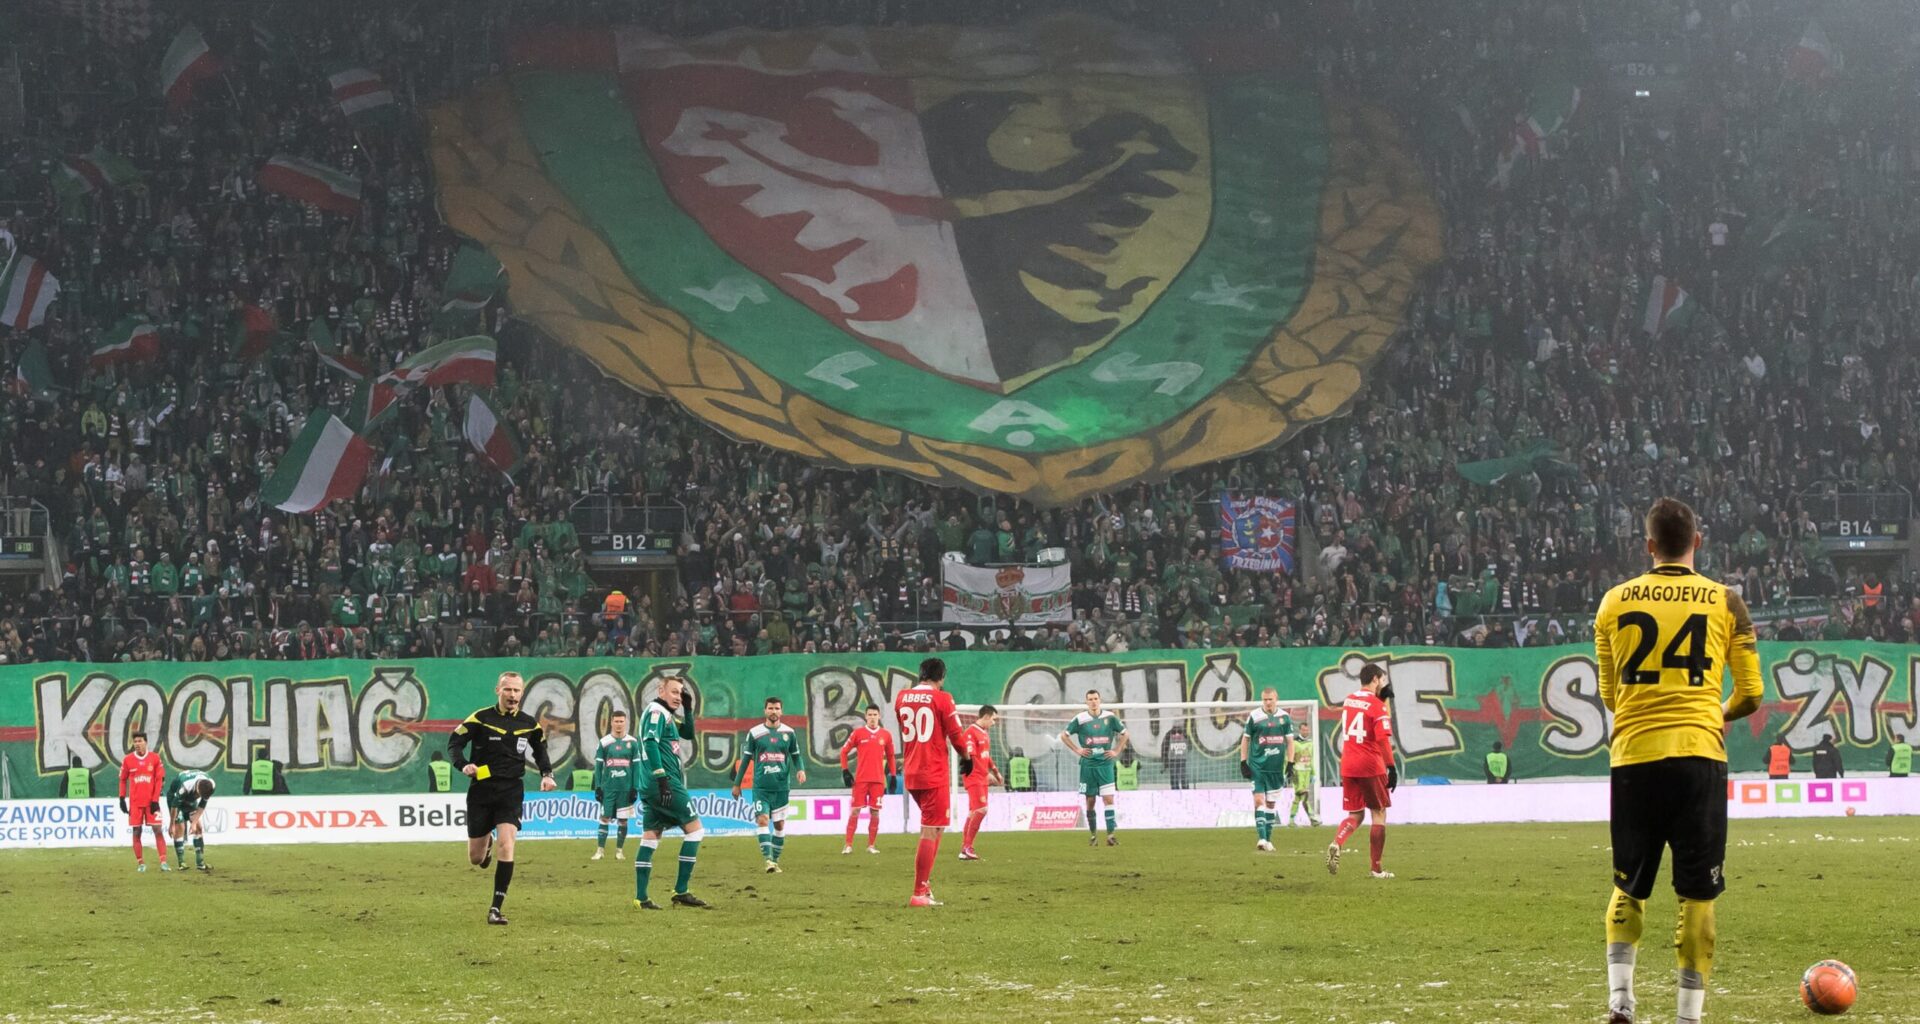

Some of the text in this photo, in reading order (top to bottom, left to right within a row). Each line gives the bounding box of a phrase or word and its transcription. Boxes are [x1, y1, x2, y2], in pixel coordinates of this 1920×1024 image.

[1626, 62, 1656, 76] B26
[1840, 520, 1873, 536] B14
[612, 534, 646, 550] B12
[1620, 585, 1718, 605] DRAGOJEVIĆ
[1617, 610, 1714, 687] 24
[901, 693, 933, 704] ABBES
[899, 706, 935, 744] 30
[1341, 709, 1368, 744] 14
[0, 805, 115, 824] ZAWODNE
[235, 809, 388, 830] HONDA
[399, 803, 468, 828] Biela
[1035, 810, 1078, 820] TAURON
[33, 823, 115, 840] SPOTKAŃ
